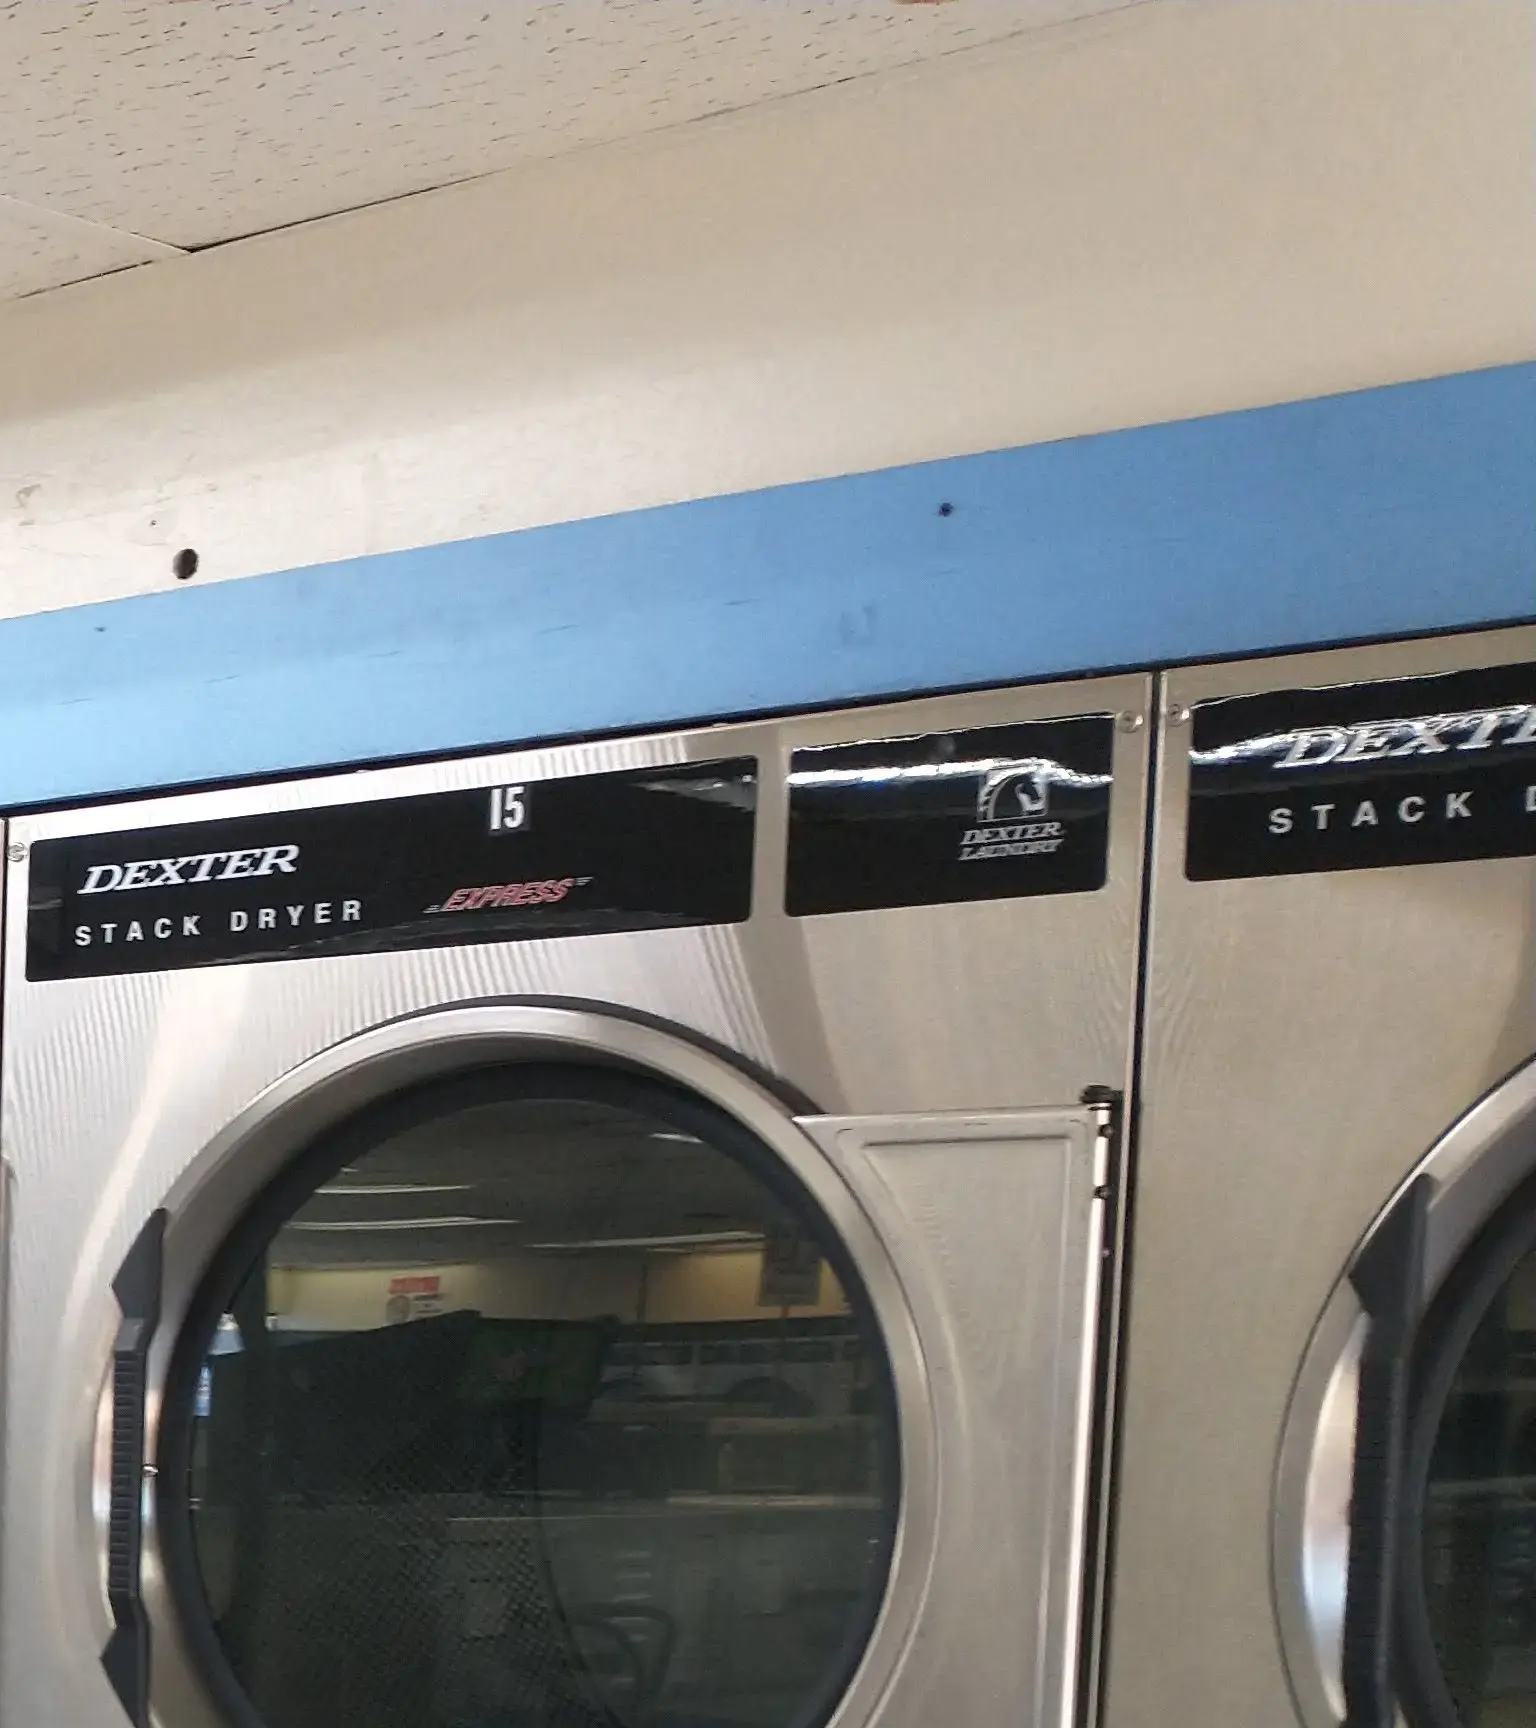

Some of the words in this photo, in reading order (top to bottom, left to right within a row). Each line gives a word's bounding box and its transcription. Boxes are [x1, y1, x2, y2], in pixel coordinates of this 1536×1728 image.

[490, 786, 526, 830] 15
[1268, 791, 1474, 834] STACK
[77, 844, 300, 894] DEXTER
[440, 878, 576, 912] EXPRESS
[75, 914, 201, 946] STACK
[230, 899, 362, 933] DRYER
